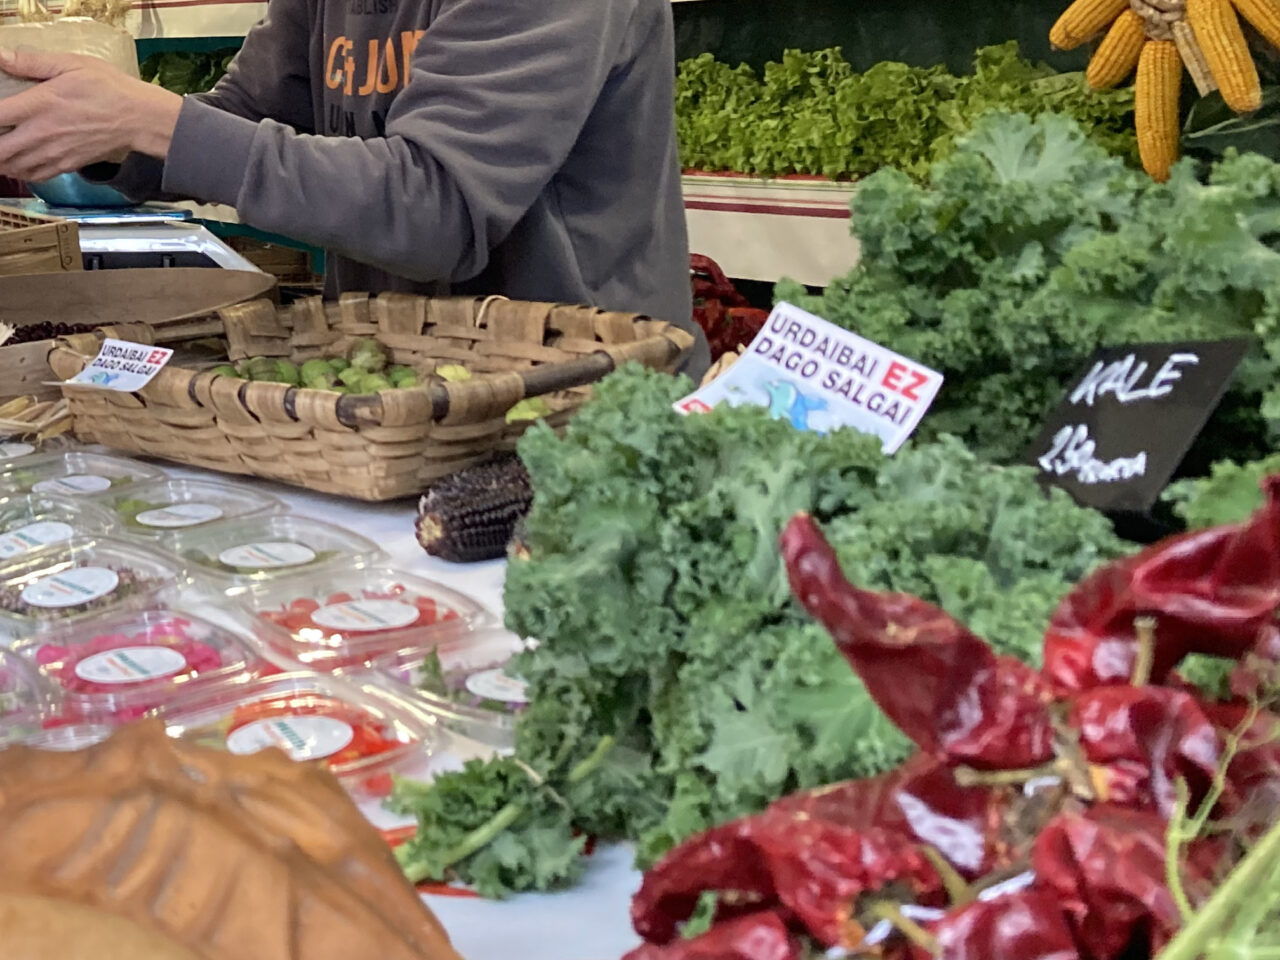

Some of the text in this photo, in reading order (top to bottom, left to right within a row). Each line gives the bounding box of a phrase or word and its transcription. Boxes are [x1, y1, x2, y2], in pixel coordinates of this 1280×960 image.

[92, 358, 157, 376] DAGO SALGAI
[101, 344, 168, 365] URDAIBAI EZ
[754, 337, 915, 426] DAGO SALGAI
[770, 312, 929, 402] URDAIBAI EZ
[1070, 353, 1200, 407] KALE
